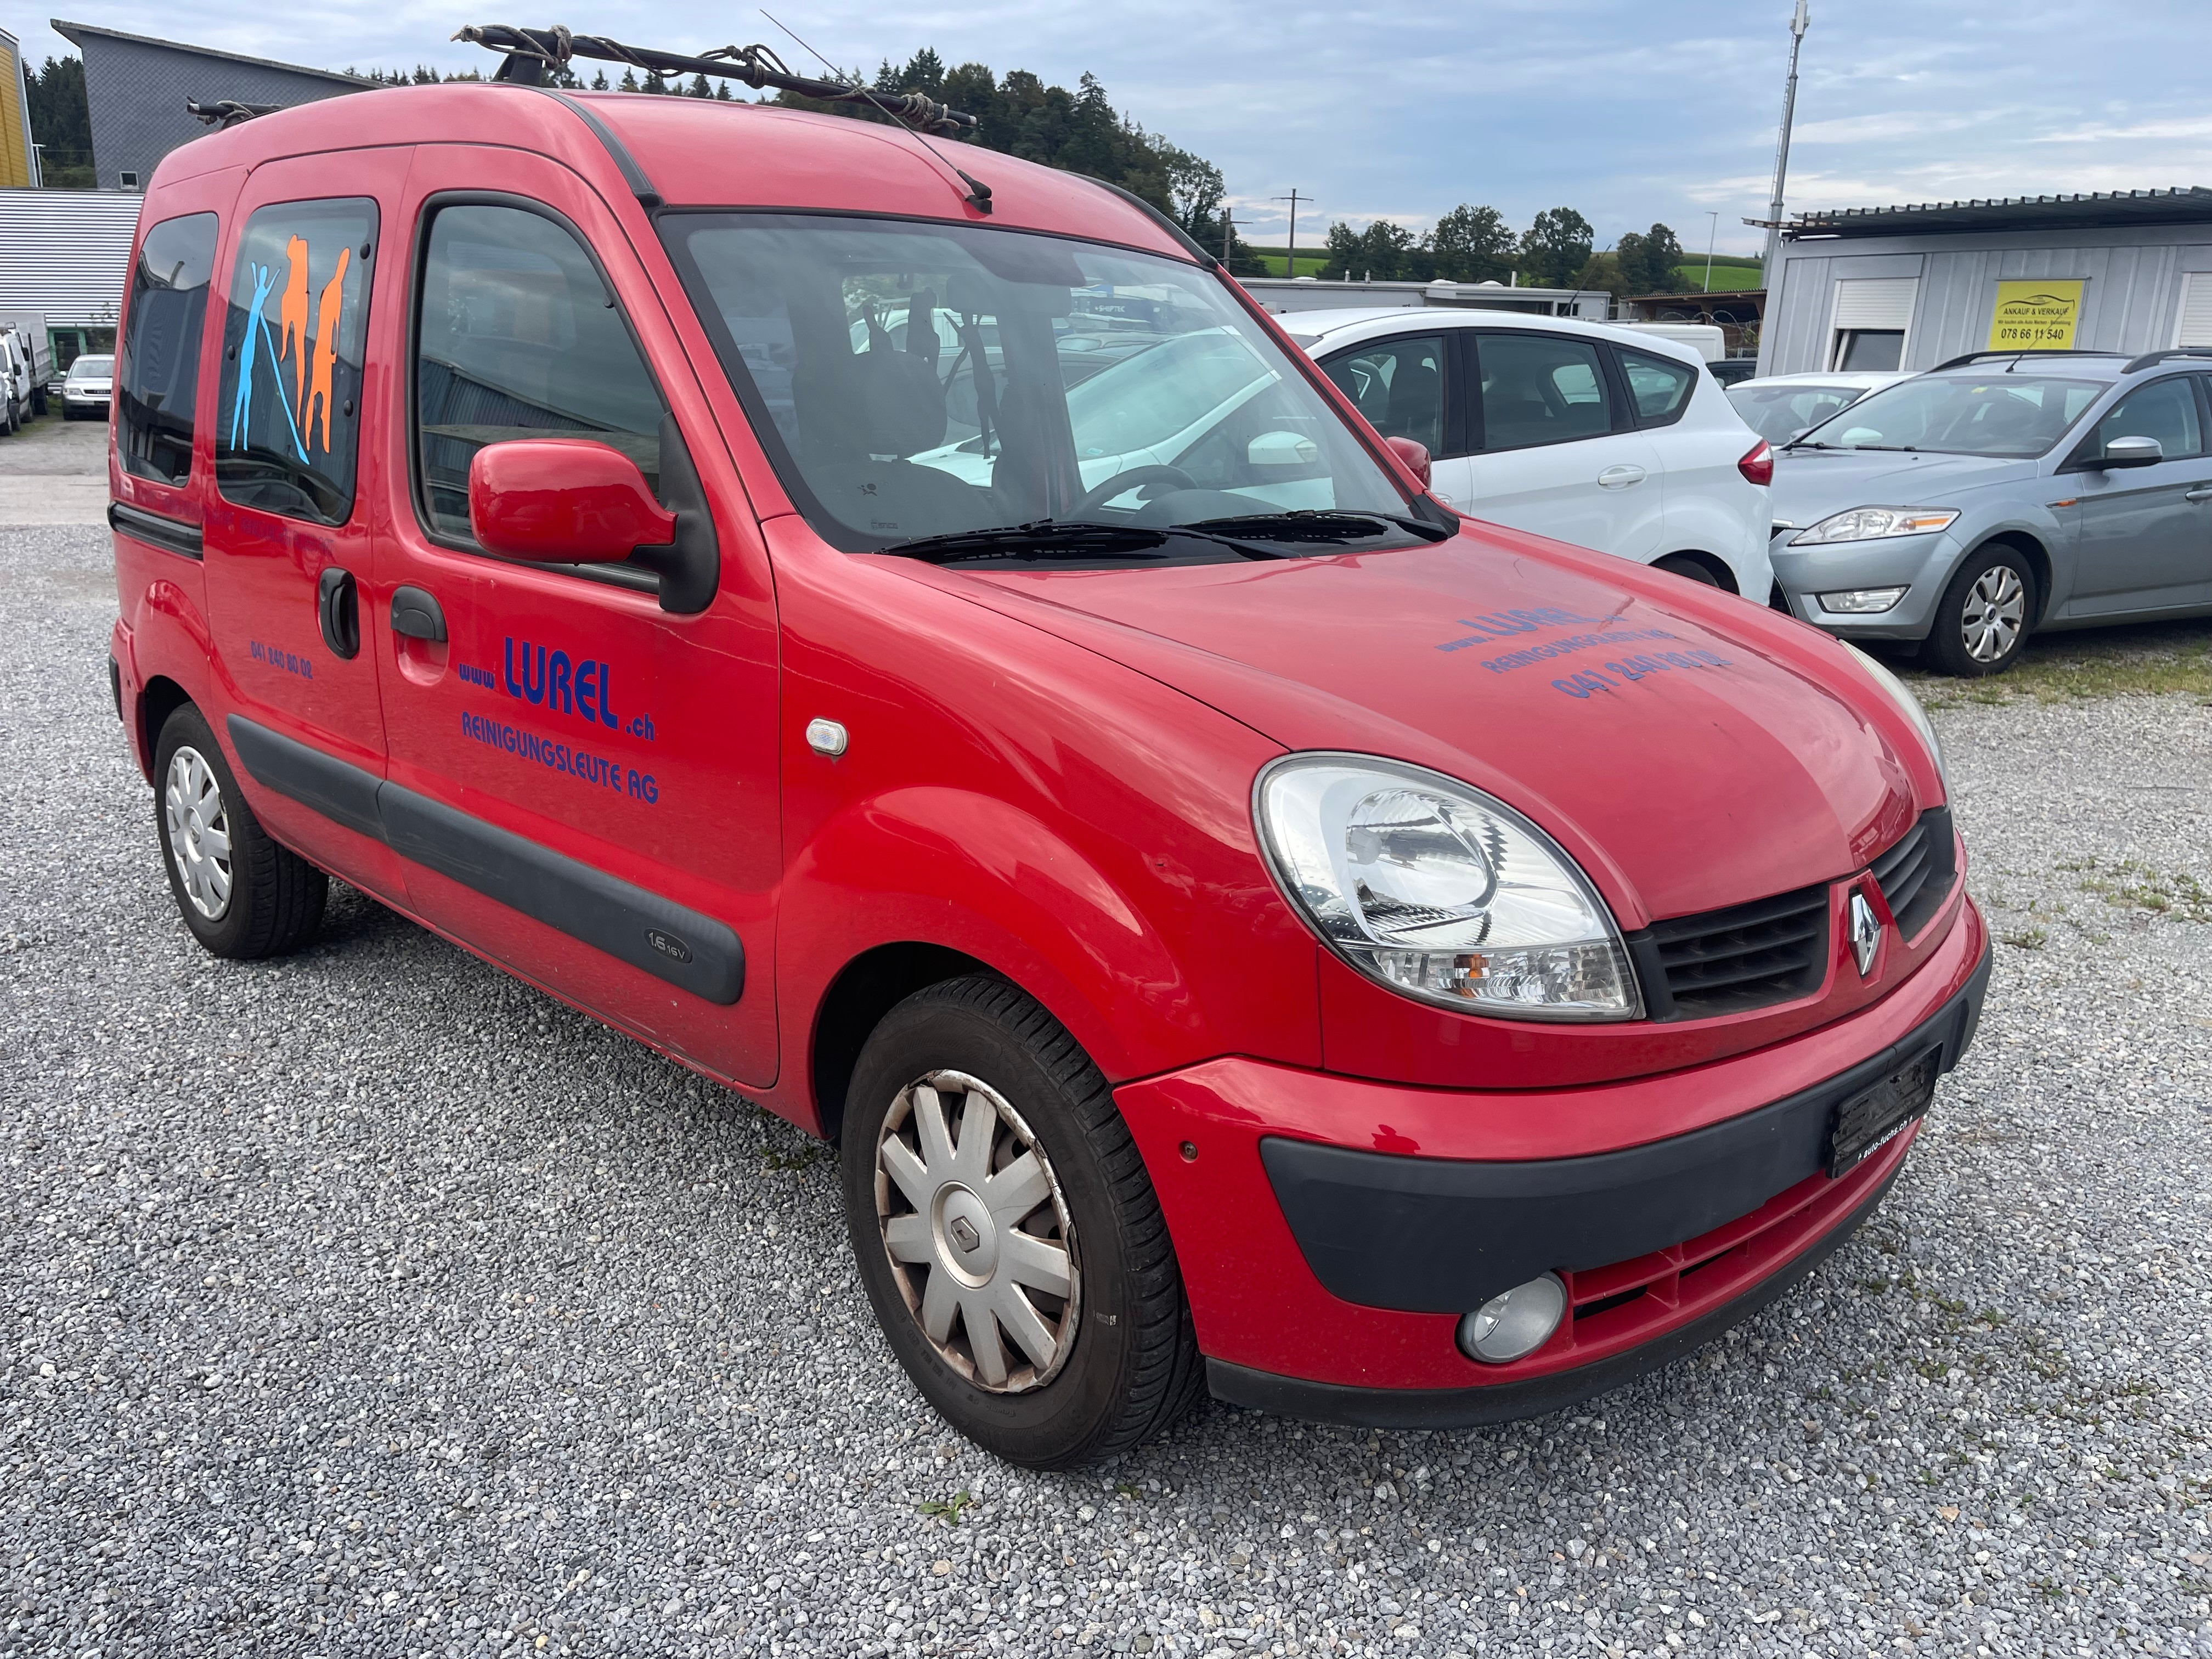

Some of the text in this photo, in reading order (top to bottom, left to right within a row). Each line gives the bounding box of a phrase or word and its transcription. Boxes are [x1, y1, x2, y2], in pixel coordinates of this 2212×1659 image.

[2003, 307, 2030, 315] ANKAUF
[2038, 307, 2068, 315] VERKAUF
[2001, 328, 2063, 340] 078 66 11 540
[251, 640, 313, 680] 041 240 80 02
[1551, 669, 1621, 698] 041
[1605, 654, 1671, 681] 240
[505, 636, 618, 730] LUREL
[461, 710, 659, 805] REINIGUNGSLEUTE AG
[667, 945, 685, 960] 16V
[1863, 1119, 1908, 1158] auto-fuchs.ch
